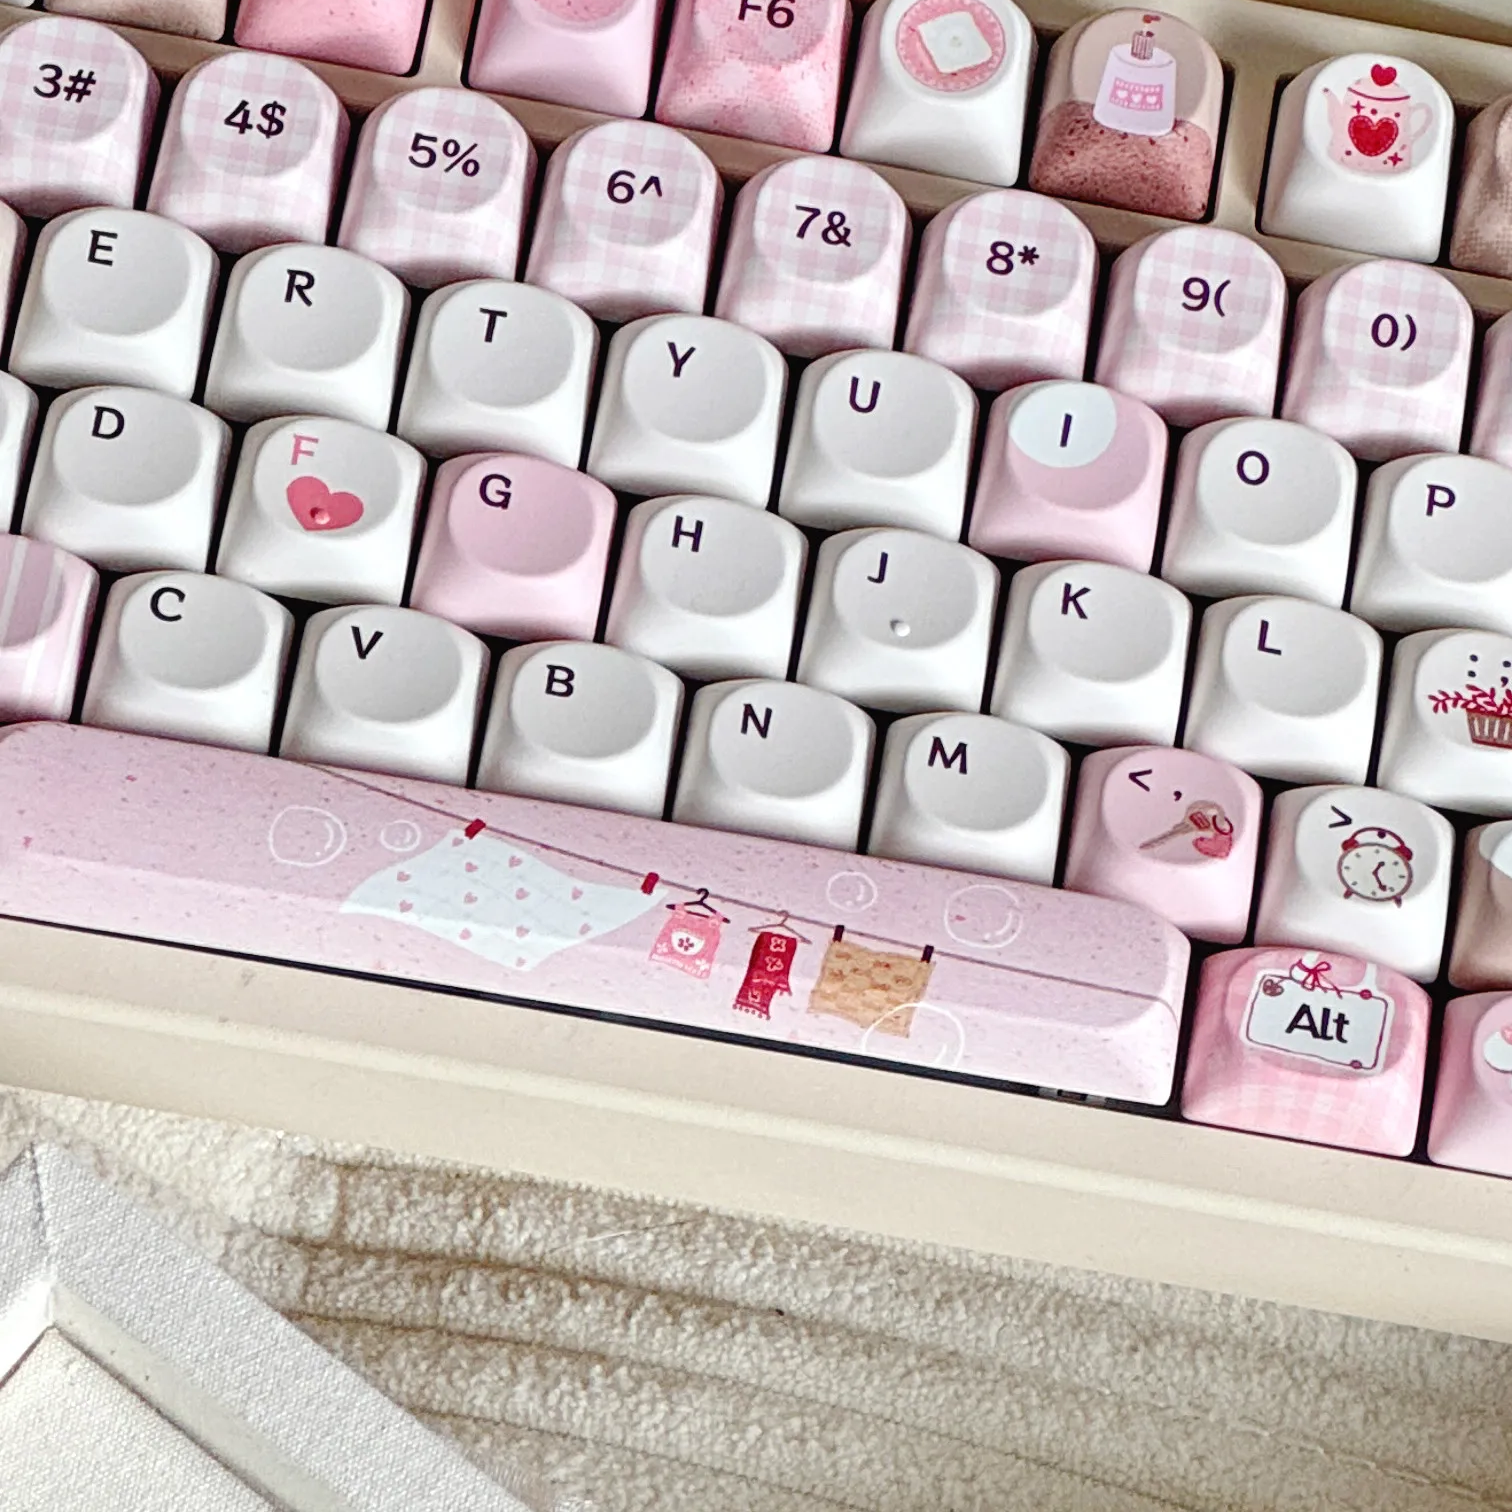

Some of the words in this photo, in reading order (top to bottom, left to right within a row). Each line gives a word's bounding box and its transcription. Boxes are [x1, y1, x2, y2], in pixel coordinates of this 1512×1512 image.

[33, 64, 97, 103] 3#
[224, 100, 287, 139] 4$
[408, 133, 481, 178] 5%
[794, 205, 852, 248] 7&
[87, 230, 118, 266] E
[285, 269, 315, 306] R
[1181, 277, 1232, 317] 9(
[479, 307, 508, 343] T
[667, 342, 696, 378] Y
[849, 376, 881, 413] U
[91, 406, 125, 440] D
[290, 434, 319, 466] F
[478, 473, 512, 510] G
[1425, 484, 1456, 517] P
[671, 516, 704, 552] H
[867, 552, 889, 584] J
[150, 586, 186, 623] C
[1061, 583, 1091, 620] K
[351, 626, 384, 660] V
[1257, 620, 1282, 655] L
[545, 665, 575, 697] B
[740, 703, 773, 739] N
[928, 736, 969, 775] M
[1285, 1005, 1350, 1044] Alt
